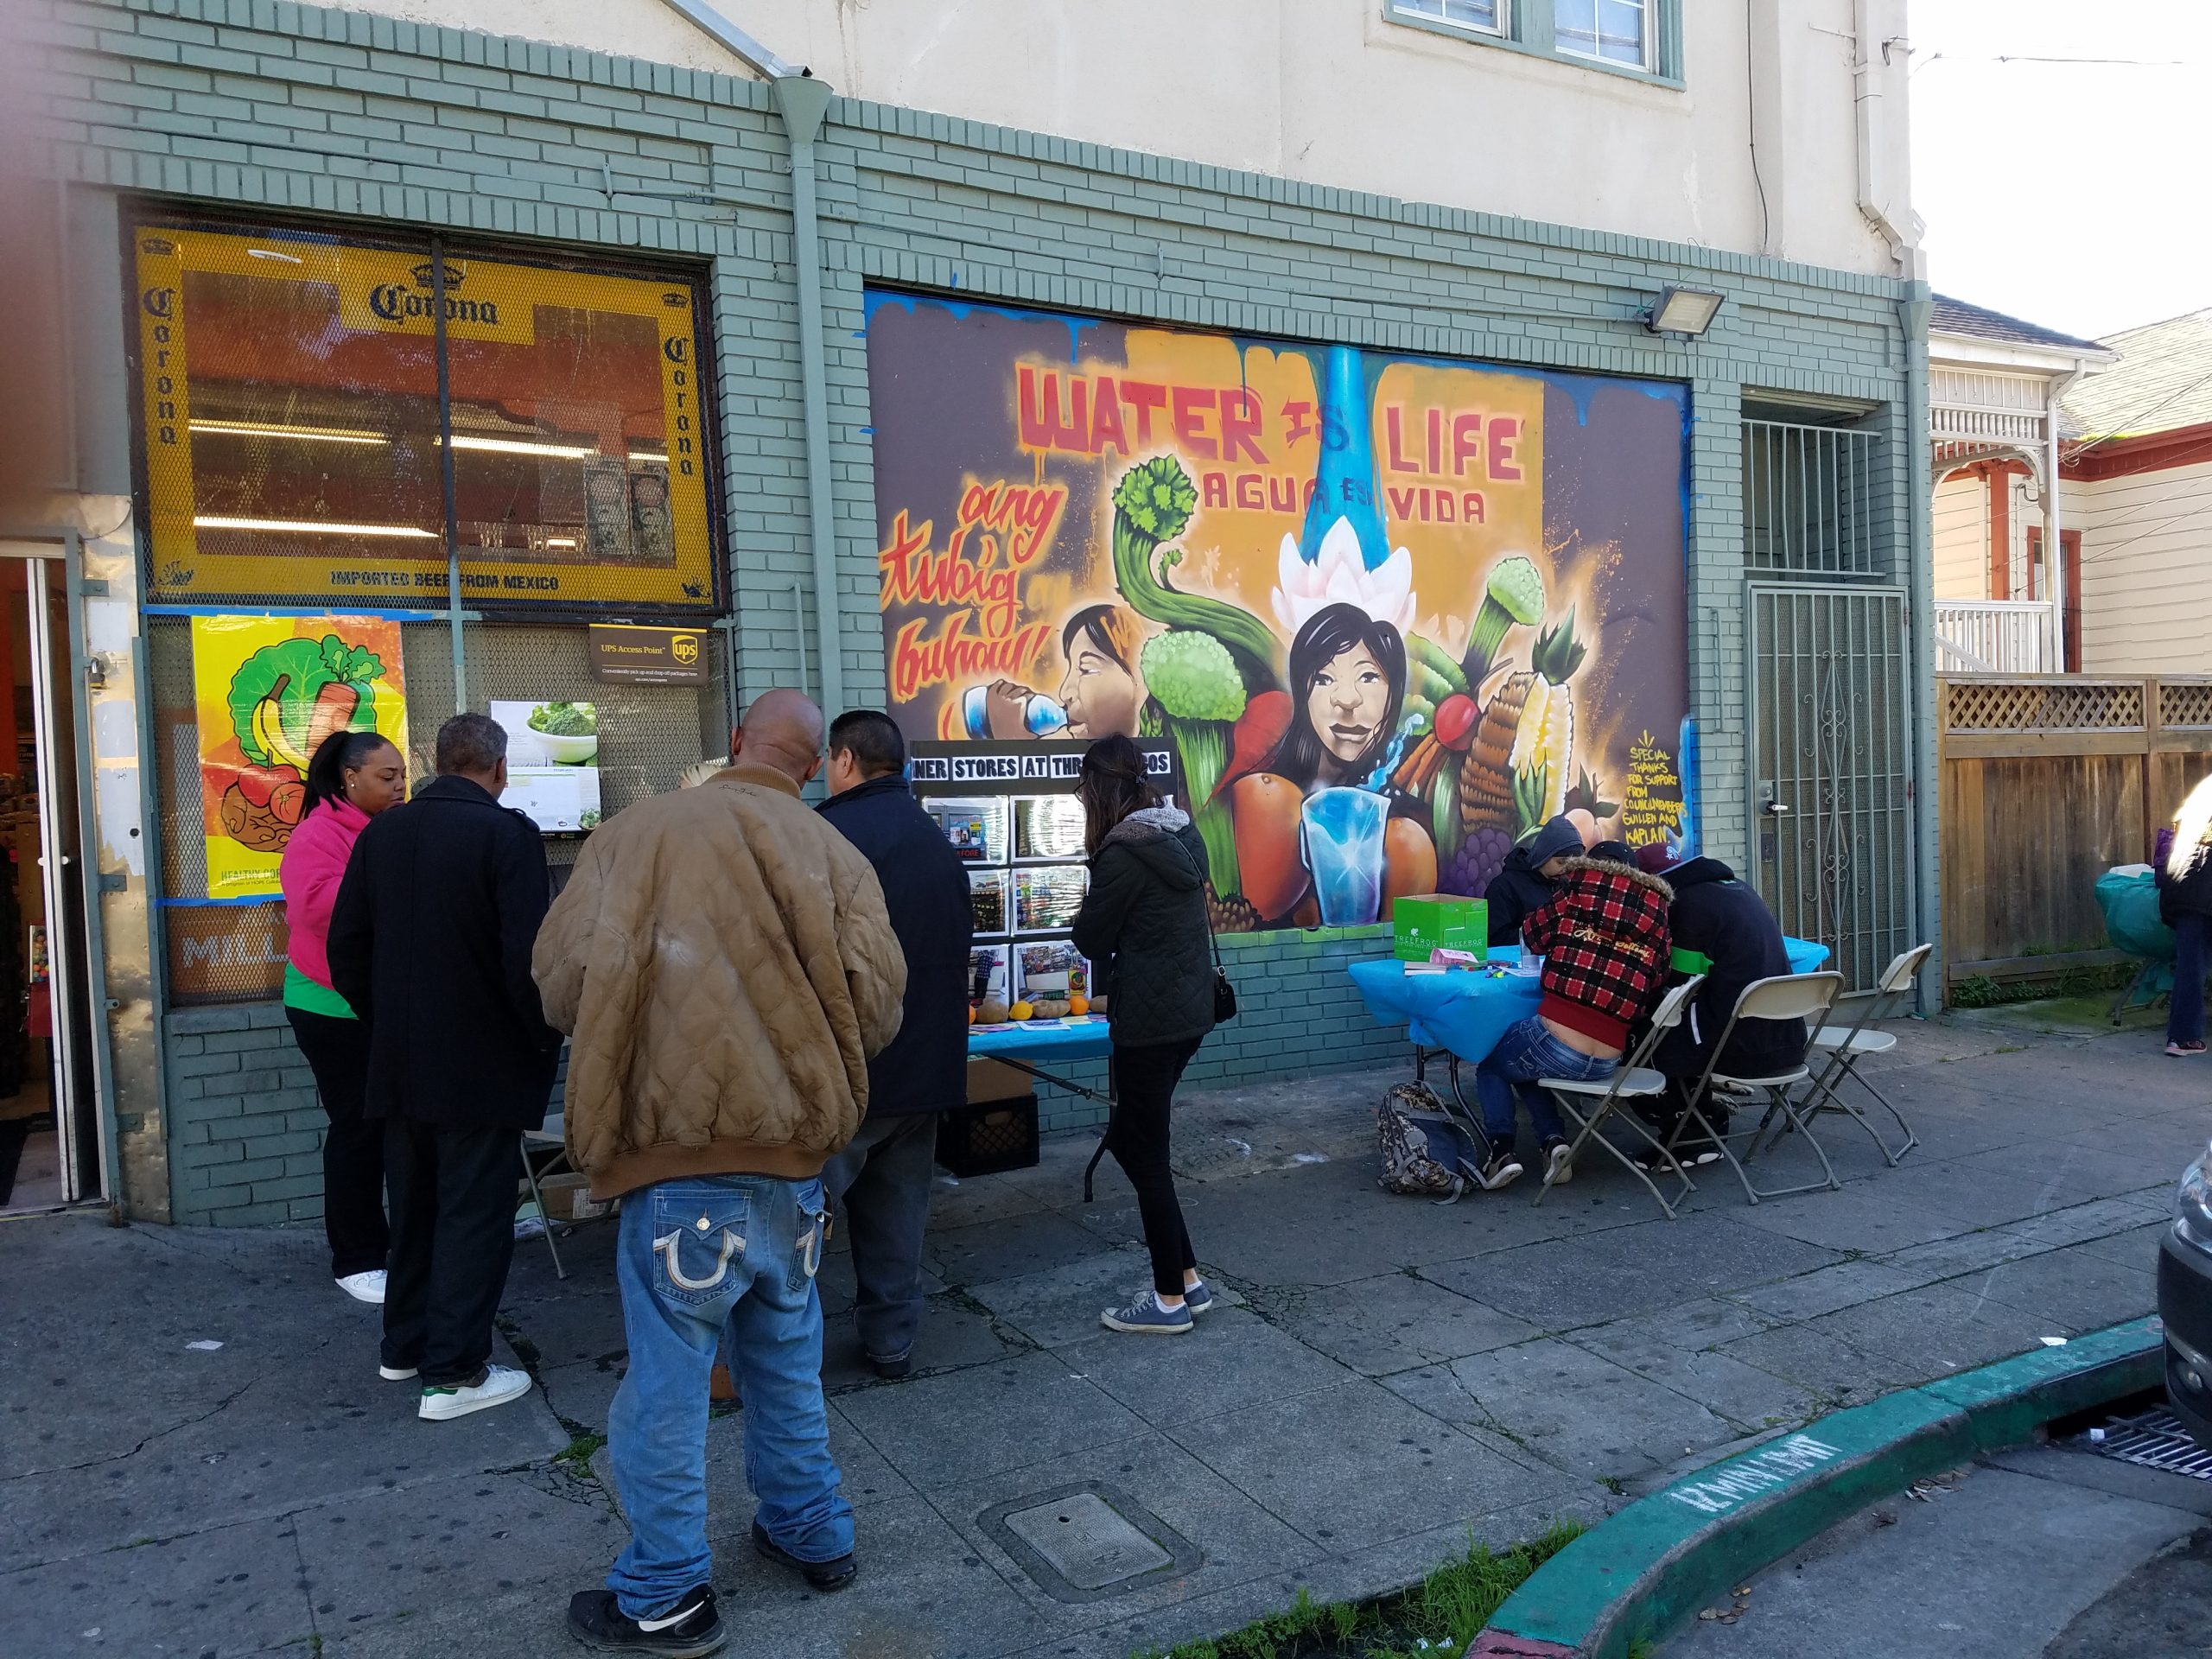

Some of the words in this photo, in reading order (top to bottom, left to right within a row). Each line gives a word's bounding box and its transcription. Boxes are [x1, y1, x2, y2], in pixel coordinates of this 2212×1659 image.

[370, 283, 499, 326] Corona
[143, 287, 176, 445] Corona
[664, 336, 693, 474] Corona
[1020, 368, 1270, 464] WATER
[1281, 399, 1349, 451] IS
[1387, 407, 1522, 480] LIFE
[1203, 473, 1331, 514] AGUA
[1388, 488, 1484, 524] VIDA
[961, 485, 1065, 564] ang
[331, 571, 410, 587] IMPORTED
[415, 573, 449, 587] BEER
[459, 574, 499, 588] FROM
[504, 575, 559, 590] MEXICO
[1630, 747, 1670, 761] SPECIAL
[914, 760, 948, 779] NER
[955, 758, 1017, 778] STORES
[1025, 757, 1046, 776] AT
[1052, 756, 1082, 776] THR
[1629, 762, 1669, 773] THANKS
[1627, 773, 1643, 785] FOR
[1645, 774, 1677, 786] SUPPORT
[1626, 785, 1648, 798] FROM
[1622, 812, 1656, 826] GUILLEN
[1659, 813, 1677, 827] AND
[1395, 935, 1437, 947] TREEFROG
[1446, 938, 1482, 948] TREEFROG
